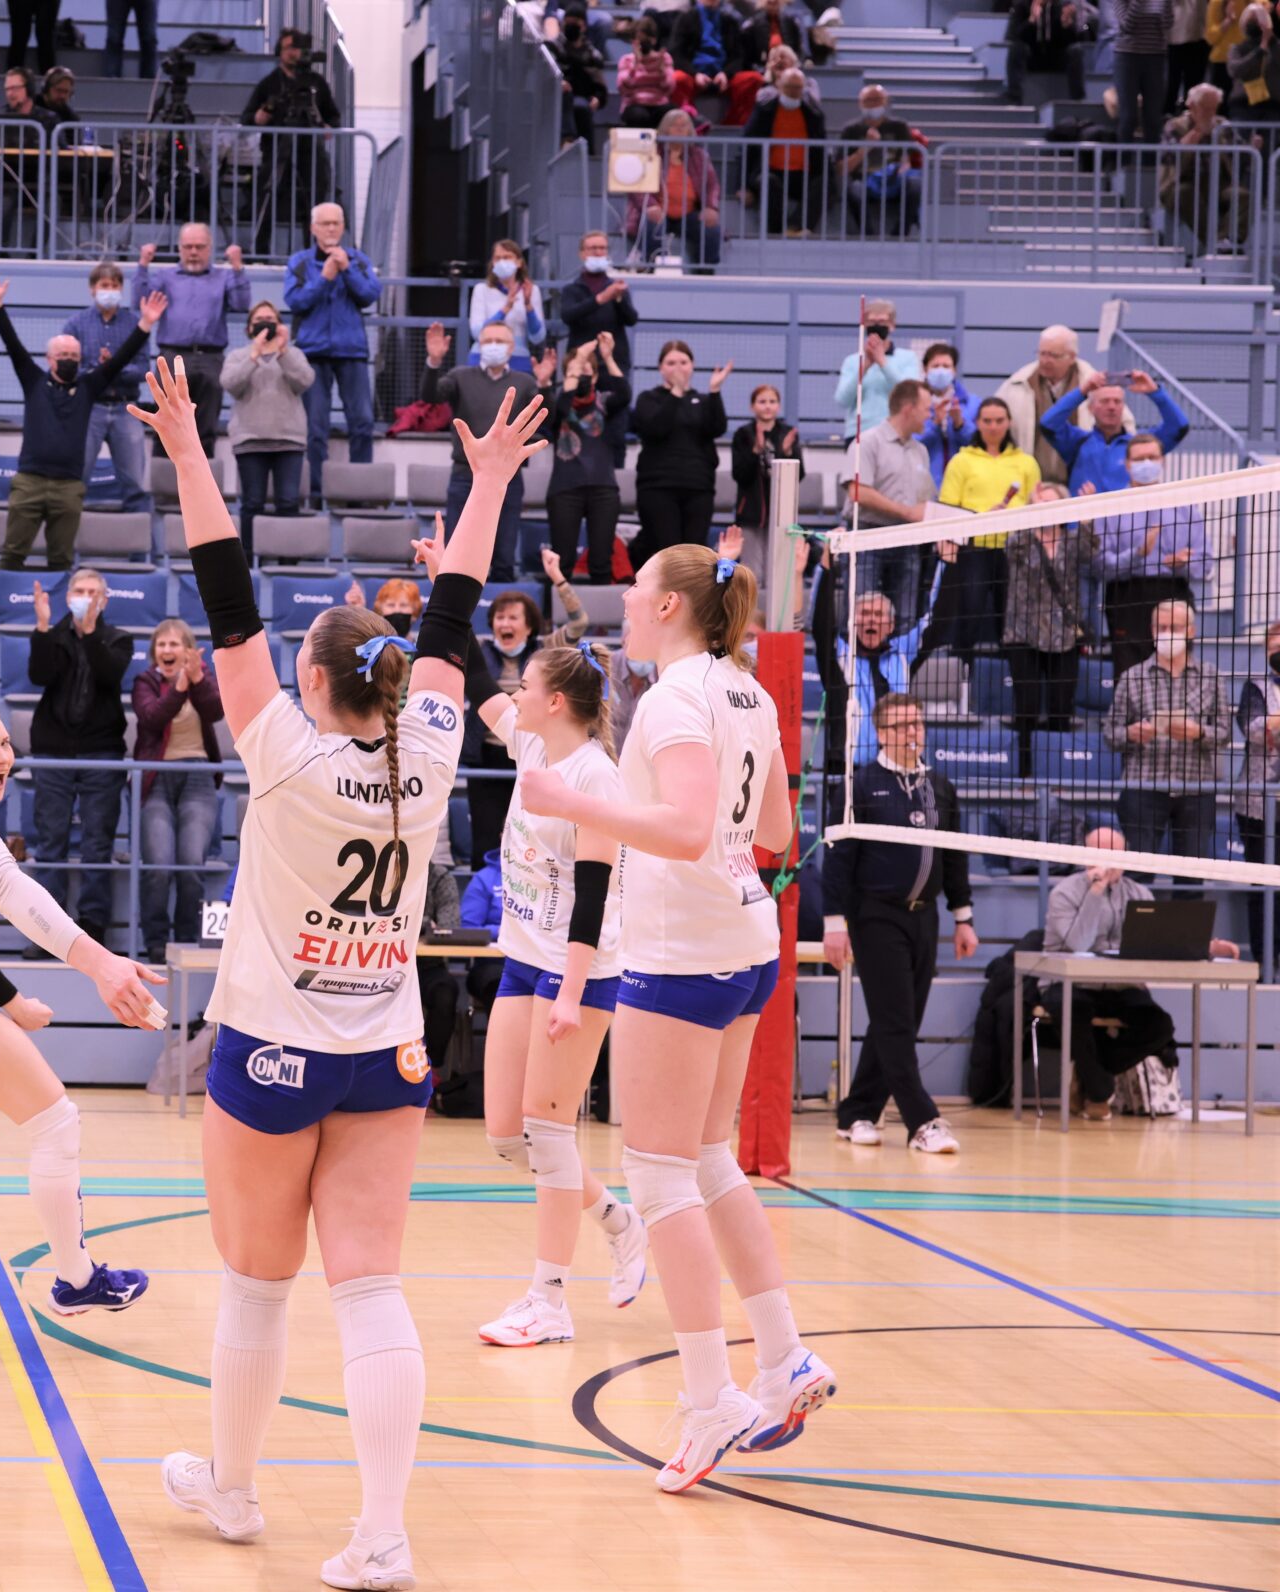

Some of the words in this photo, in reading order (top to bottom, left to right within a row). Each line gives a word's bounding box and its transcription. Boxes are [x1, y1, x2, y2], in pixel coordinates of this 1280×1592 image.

[419, 697, 455, 729] INNO
[732, 750, 755, 825] 3
[330, 838, 409, 917] 20
[292, 931, 409, 969] ELIVIN
[255, 1056, 299, 1084] ONNI
